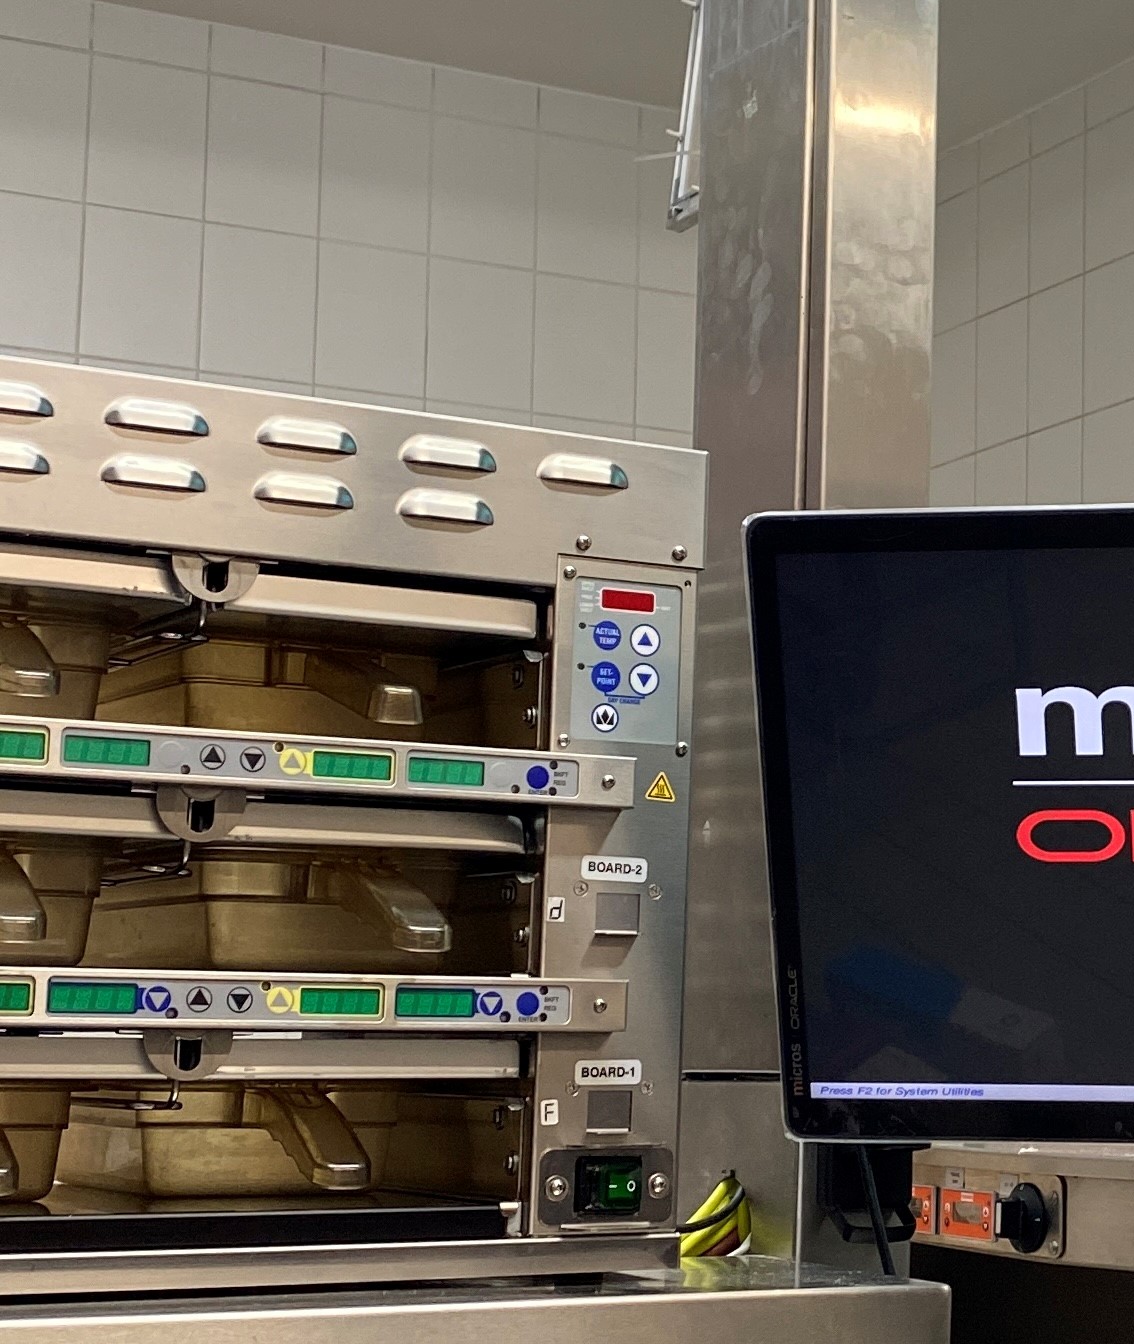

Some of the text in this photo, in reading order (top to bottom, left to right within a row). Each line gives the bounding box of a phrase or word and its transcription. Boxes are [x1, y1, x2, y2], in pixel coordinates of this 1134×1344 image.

[595, 627, 620, 637] ACTUAL
[587, 861, 643, 875] BOARD-2
[787, 967, 805, 1096] micros ORACLE
[581, 1067, 636, 1079] BOARD-1
[820, 1086, 985, 1098] Press F2 for System Utilities
[544, 1103, 556, 1122] F
